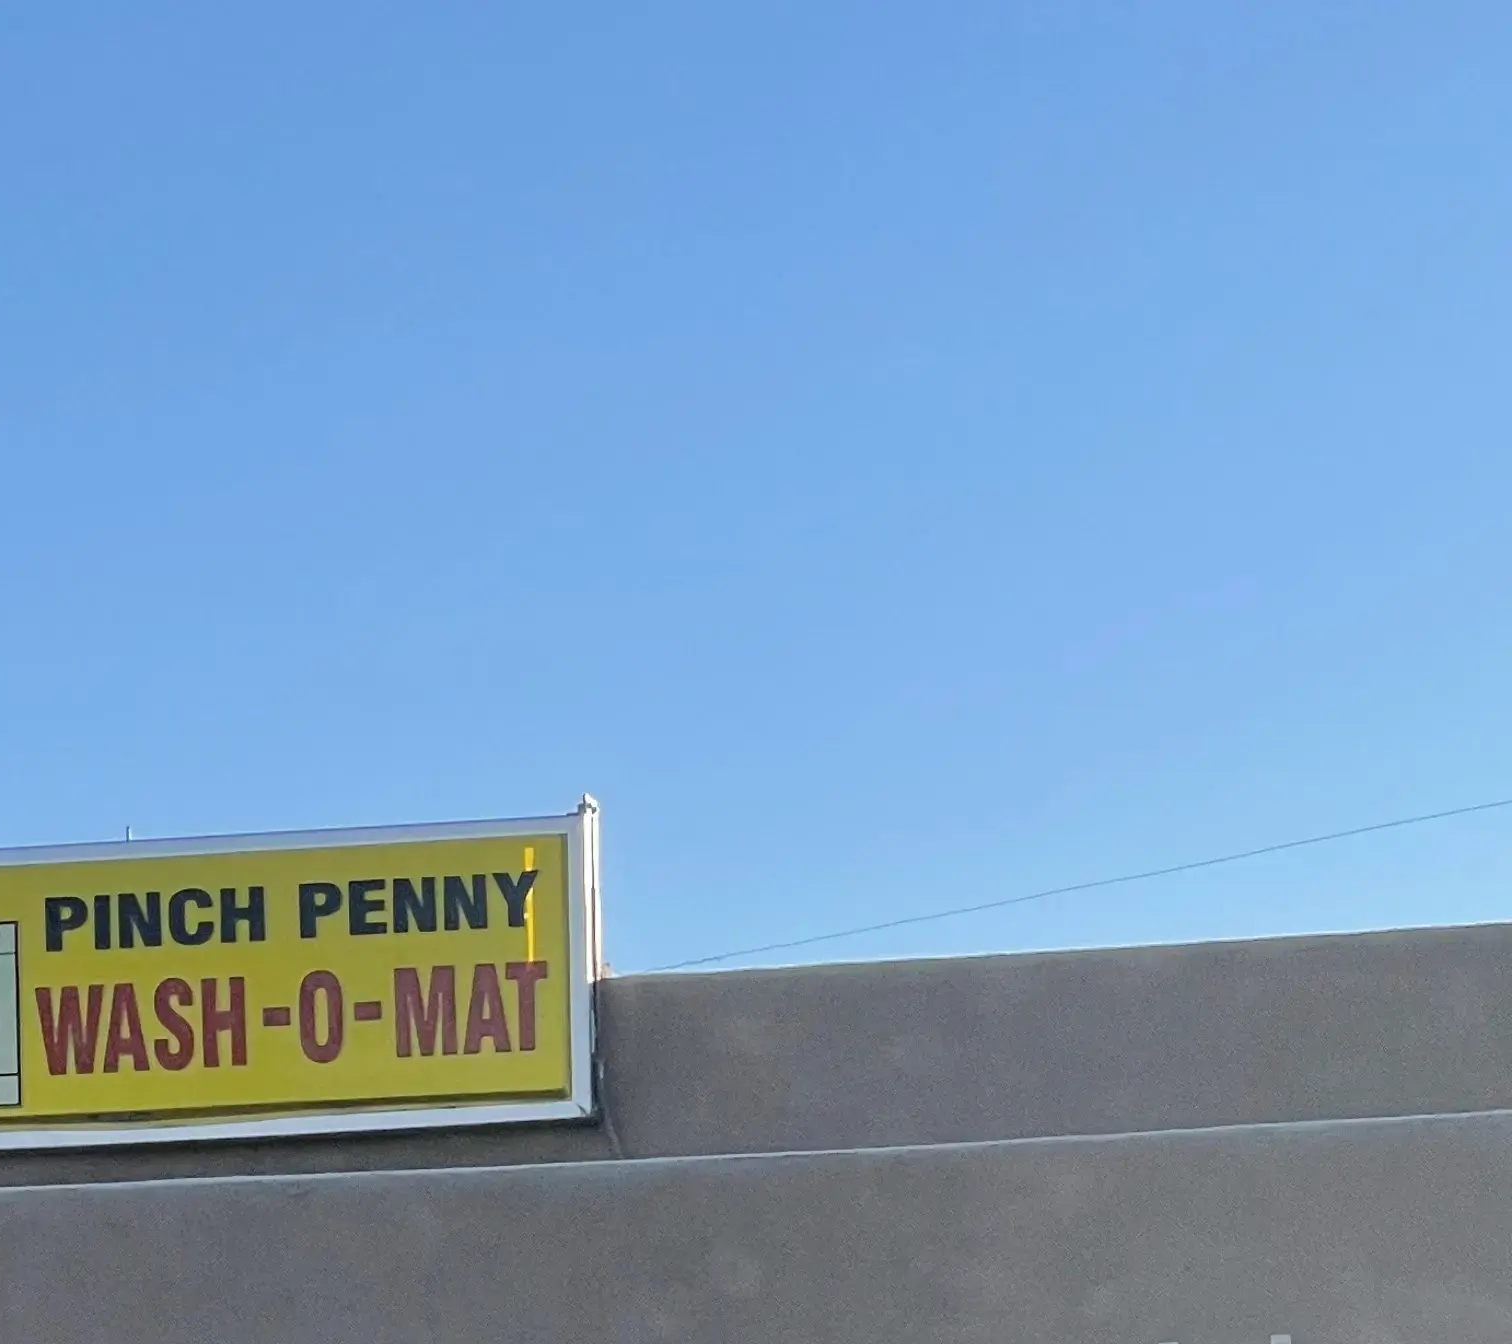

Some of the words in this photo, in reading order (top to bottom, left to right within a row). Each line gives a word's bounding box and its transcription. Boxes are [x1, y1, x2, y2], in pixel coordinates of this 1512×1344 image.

[45, 885, 263, 953] PINCH
[298, 870, 537, 940] PENNY
[35, 962, 548, 1076] WASH-O-MAT
